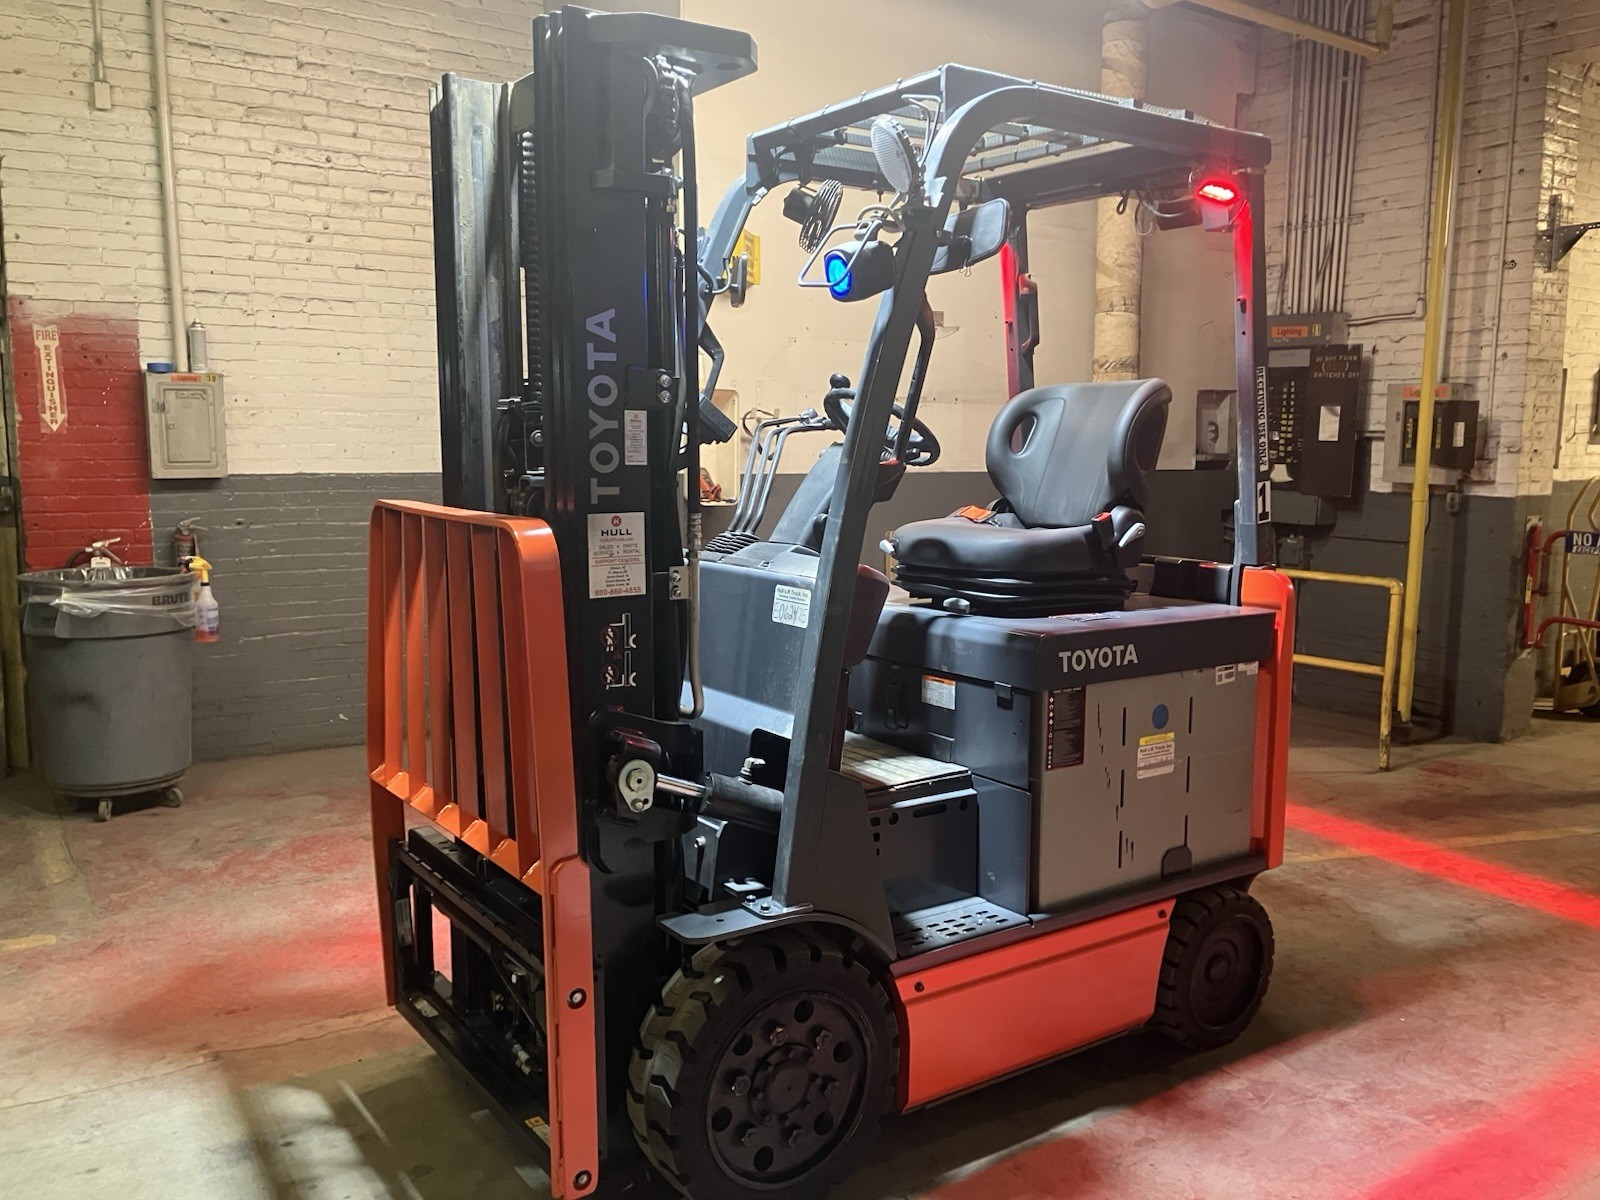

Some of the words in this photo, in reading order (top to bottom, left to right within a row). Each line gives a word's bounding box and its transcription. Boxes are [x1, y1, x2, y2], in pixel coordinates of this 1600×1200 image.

[35, 329, 58, 341] FIRE
[1276, 327, 1303, 336] Lighting
[43, 344, 59, 426] EXTINGUISHER
[1256, 367, 1266, 420] RECEIVING
[585, 307, 621, 505] TOYOTA
[1259, 441, 1267, 466] ONLY
[1258, 482, 1270, 521] 1
[601, 528, 632, 537] HULL
[1572, 532, 1593, 547] NO
[152, 591, 190, 606] BRUTE
[1058, 643, 1139, 673] TOYOTA
